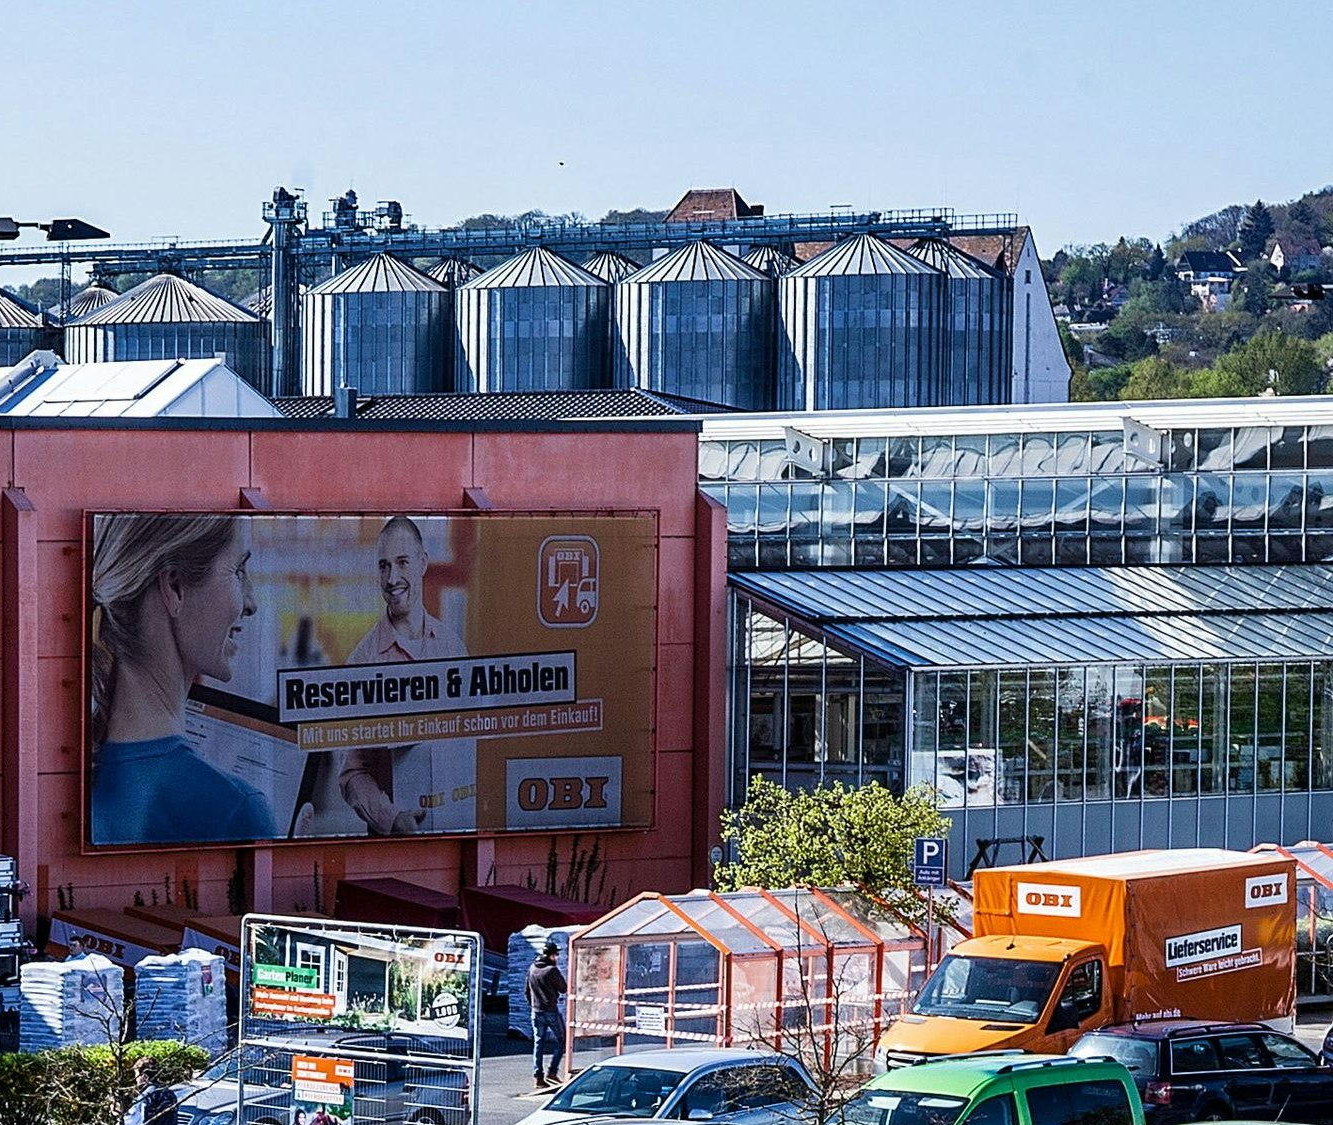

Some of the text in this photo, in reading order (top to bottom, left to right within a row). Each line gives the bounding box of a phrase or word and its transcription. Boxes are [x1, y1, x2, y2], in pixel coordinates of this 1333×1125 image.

[286, 662, 568, 710] Reservieren & Abholen
[303, 706, 598, 745] Mit uns startet Ihr Einkauf schon vor dem Einkauf!
[518, 777, 609, 811] OBI
[924, 841, 939, 864] P
[1026, 892, 1073, 908] OBI
[1250, 882, 1283, 899] OBI
[84, 935, 126, 959] OBI
[1168, 932, 1237, 960] Lieferservice
[434, 952, 465, 965] OBI
[1179, 967, 1203, 977] Schwere
[1203, 963, 1217, 973] Ware
[1218, 958, 1234, 969] leicht
[435, 1004, 458, 1017] 1.000
